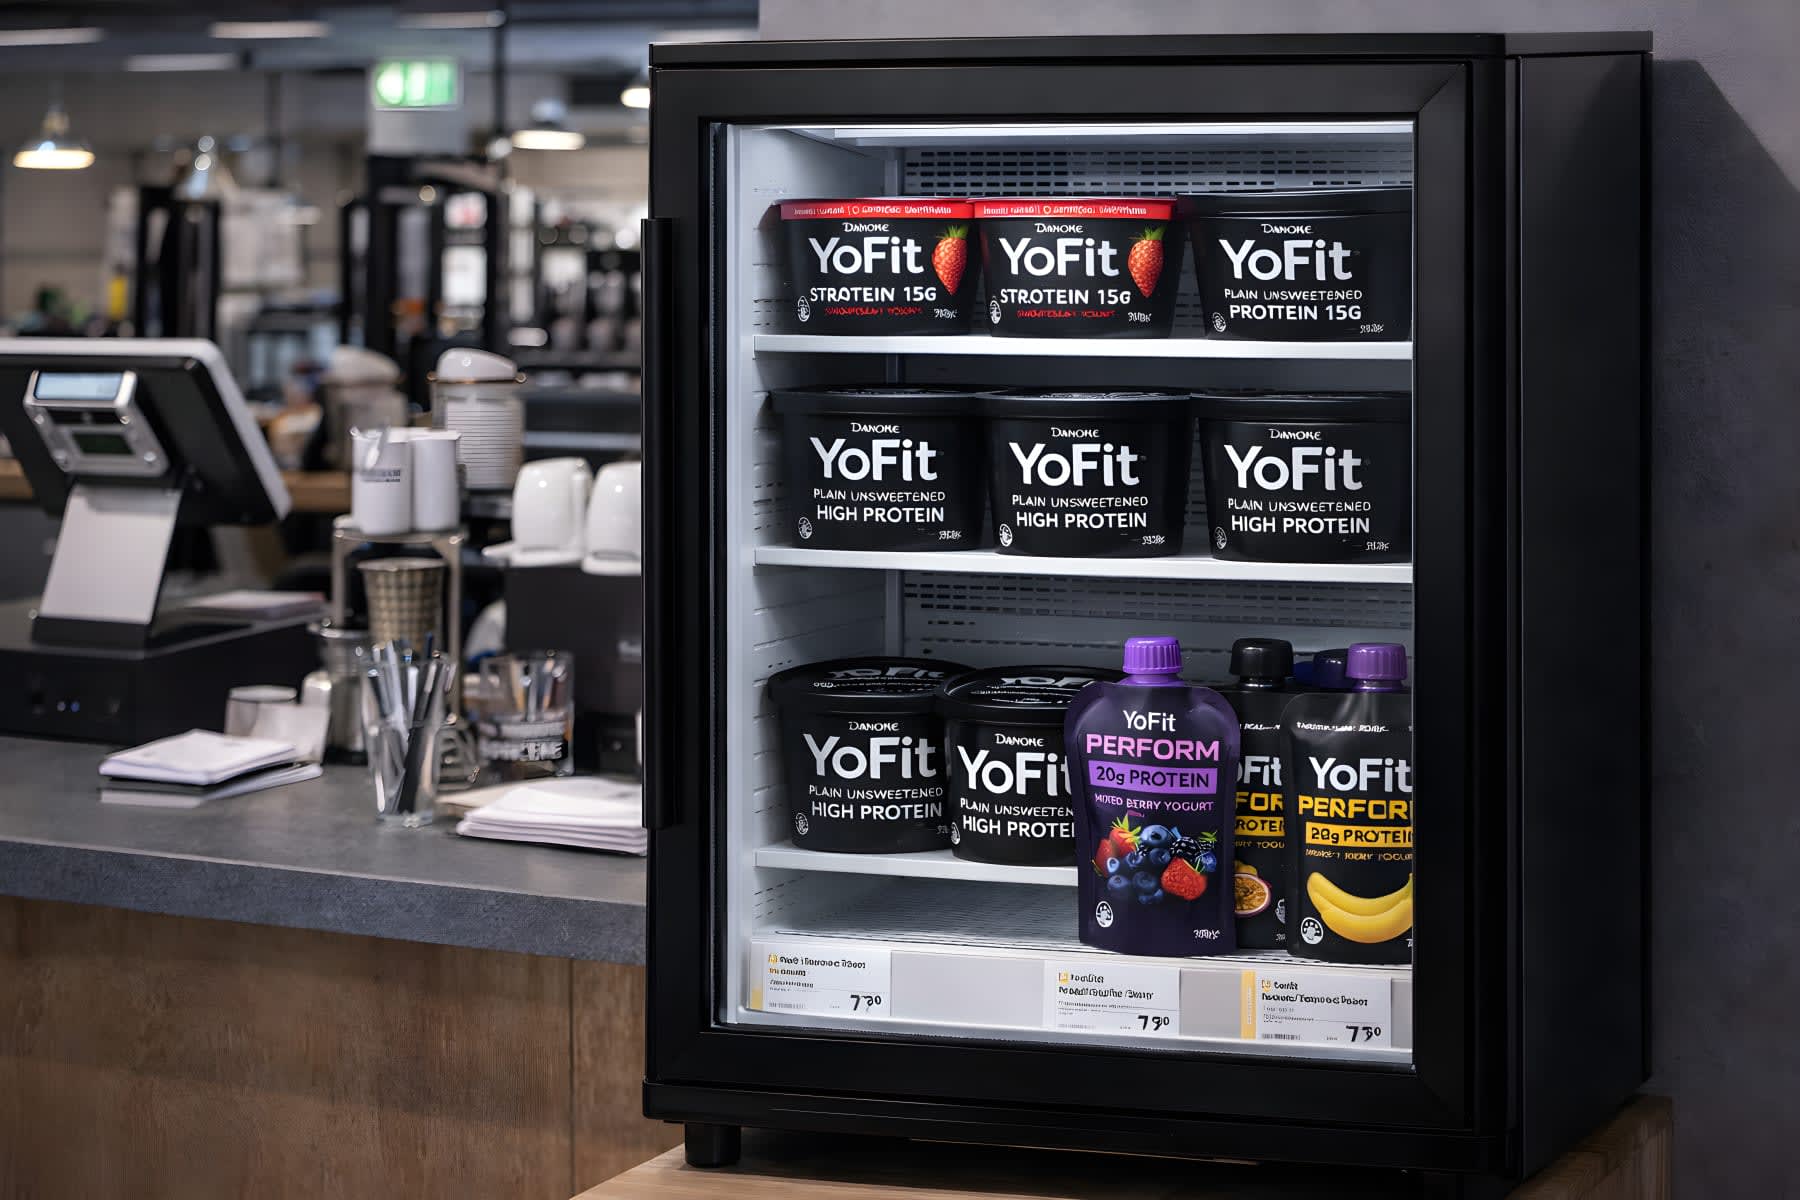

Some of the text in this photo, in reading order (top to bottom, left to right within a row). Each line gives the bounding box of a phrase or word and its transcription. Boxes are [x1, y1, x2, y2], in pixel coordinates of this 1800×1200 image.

[808, 236, 924, 274] YoFit
[998, 237, 1120, 277] YoFit
[1218, 239, 1352, 281] YoFit
[904, 287, 937, 301] 15G
[1097, 289, 1131, 305] 15G
[1224, 288, 1363, 301] PLAIN UNSWEETENED
[1325, 305, 1362, 321] 15G
[809, 437, 938, 481] YoFit
[1008, 442, 1140, 487] YoFit
[1223, 444, 1364, 491] YoFit
[813, 487, 946, 503] PLAIN UNSWEETENED
[1012, 494, 1149, 508] PLAIN UNSWEETENED
[817, 504, 944, 523] HIGH PROTEIN
[1228, 498, 1371, 513] PLAIN UNSWEETENED
[1016, 511, 1147, 528] HIGH PROTEIN
[1231, 515, 1370, 534] HIGH PROTEIN
[1123, 709, 1176, 732] YoFit
[802, 733, 937, 779] YoFit
[1086, 733, 1220, 762] PERFORM
[1096, 766, 1209, 788] 20g PROTEIN
[1237, 756, 1282, 786] Fit
[1308, 756, 1412, 793] YoFit
[809, 785, 943, 800] PLAIN UNSWEETENED
[812, 801, 942, 820] HIGH PROTEIN
[960, 798, 1074, 817] PLAIN UNSWEETEN
[1298, 795, 1412, 820] PERFOR
[962, 814, 1001, 836] HIGH
[1007, 821, 1075, 838] PROTEI
[1236, 820, 1282, 832] ROTEI
